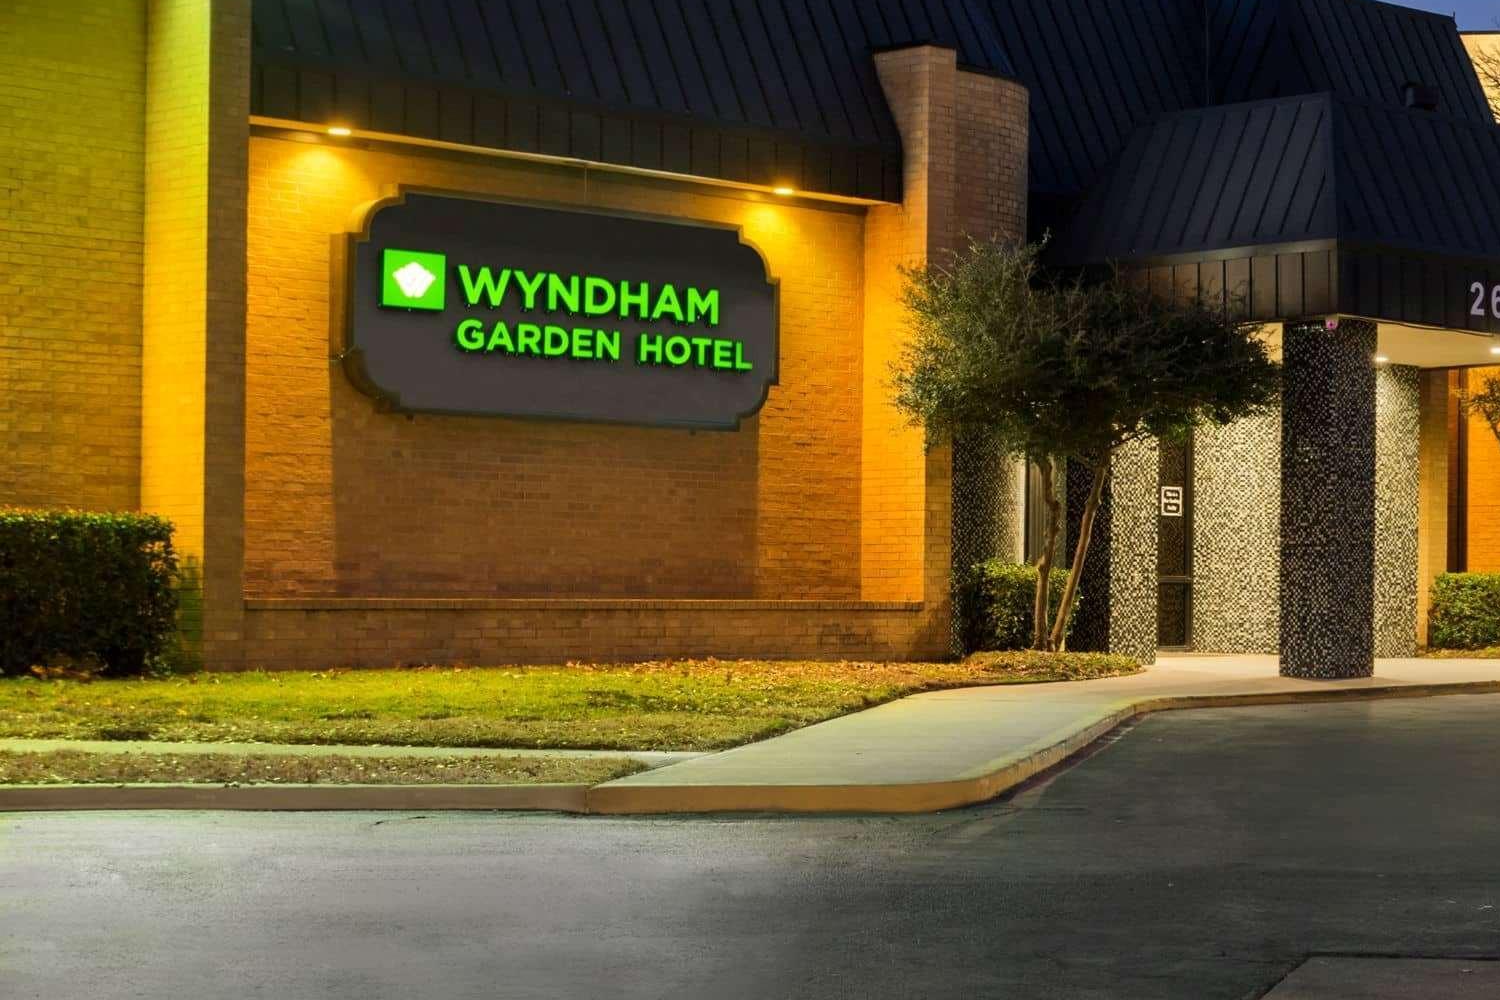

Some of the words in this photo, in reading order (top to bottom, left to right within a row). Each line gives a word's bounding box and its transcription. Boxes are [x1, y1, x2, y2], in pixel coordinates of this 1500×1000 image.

[458, 264, 719, 325] WYNDHAM
[457, 319, 620, 360] GARDEN
[640, 333, 754, 370] HOTEL
